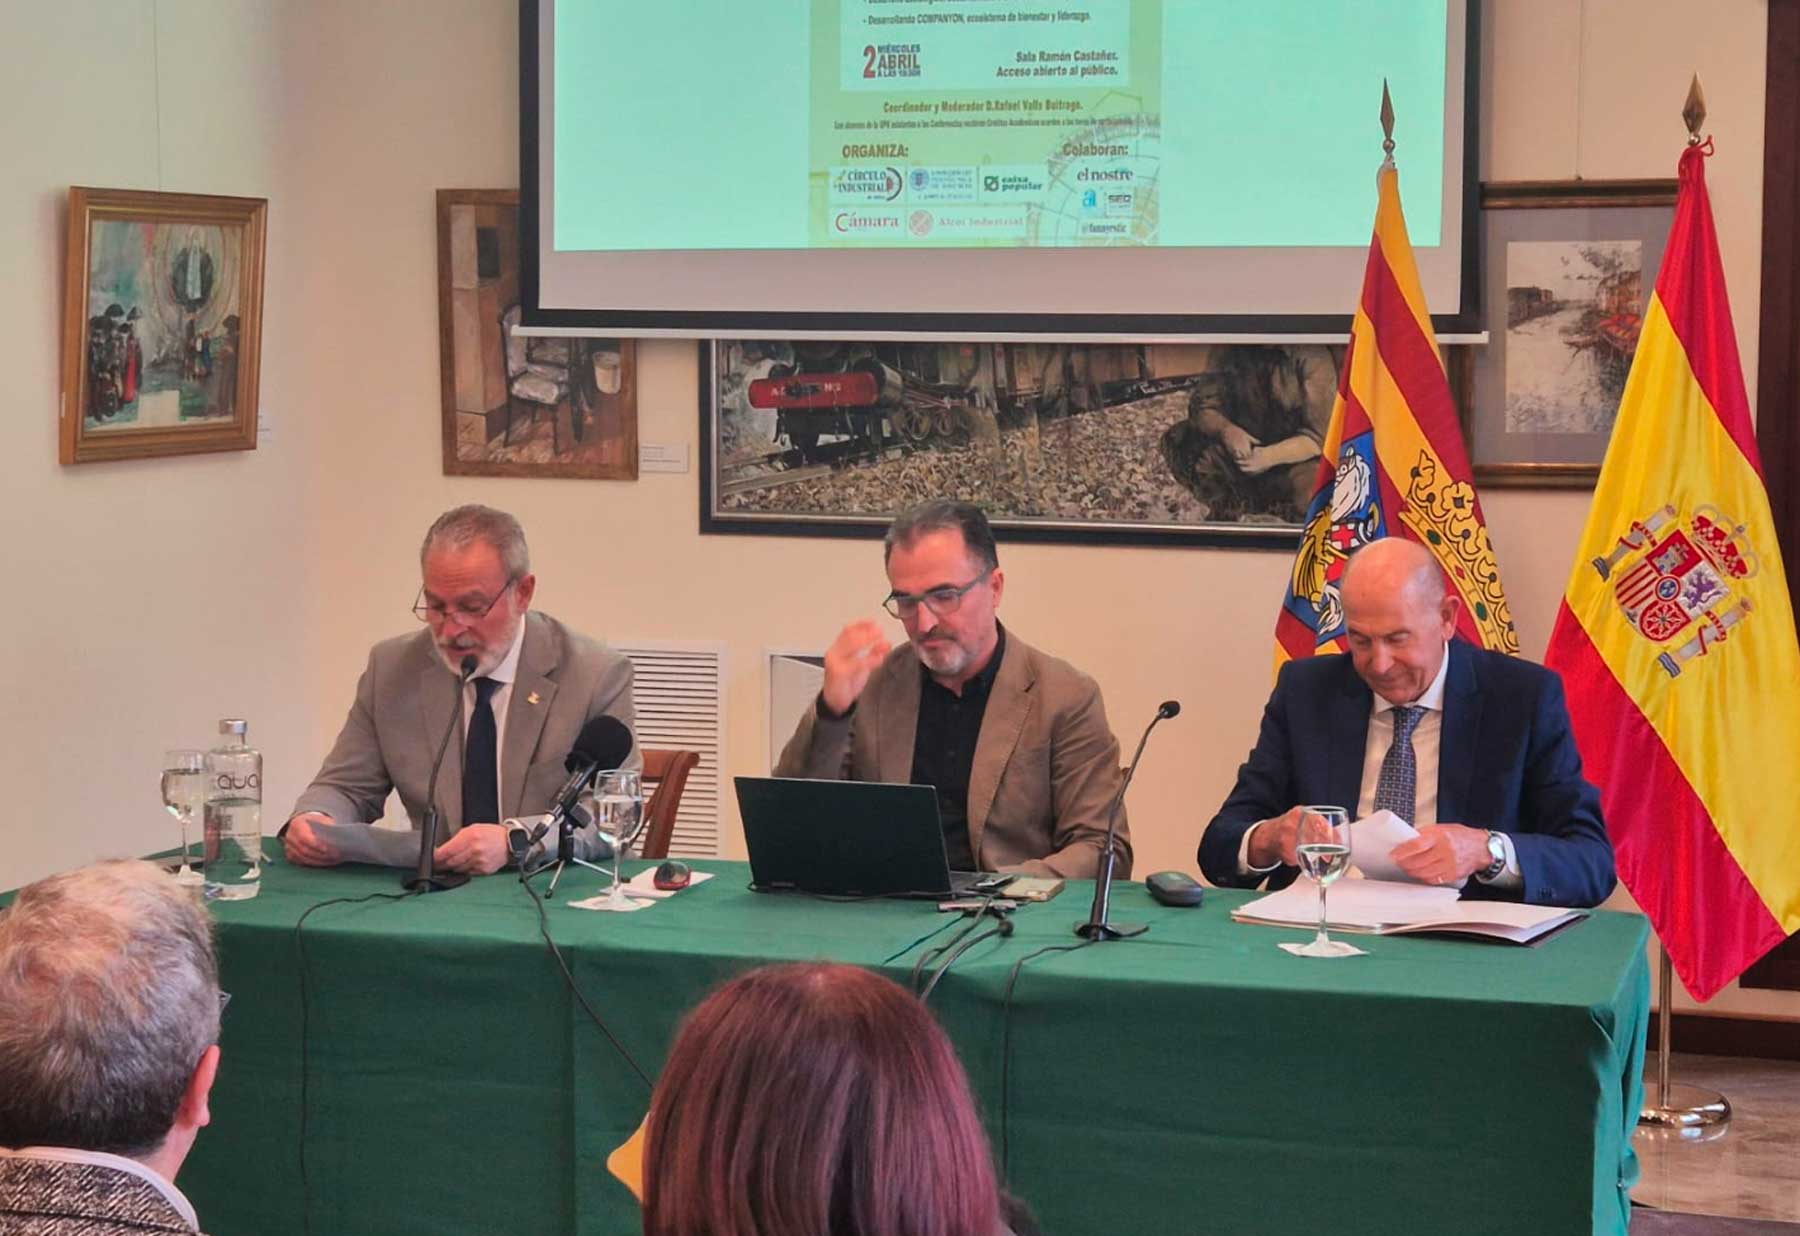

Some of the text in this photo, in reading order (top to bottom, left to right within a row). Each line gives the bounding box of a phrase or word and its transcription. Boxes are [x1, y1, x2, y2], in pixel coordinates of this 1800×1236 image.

[863, 45, 876, 79] 2
[877, 54, 921, 69] ABRIL
[1015, 51, 1037, 63] Sala
[1039, 50, 1071, 62] Ramón
[996, 63, 1119, 78] Acceso abierto al público.
[883, 101, 932, 113] Coordinador
[933, 103, 940, 115] y
[941, 100, 985, 112] Moderador
[842, 144, 909, 158] ORGANIZA:
[1063, 142, 1129, 157] Colaboran:
[1001, 175, 1029, 183] caixa
[1077, 167, 1134, 182] el nostre
[838, 182, 890, 193] INDUSTRIAL
[1002, 182, 1043, 192] popular
[835, 211, 899, 232] Cámara
